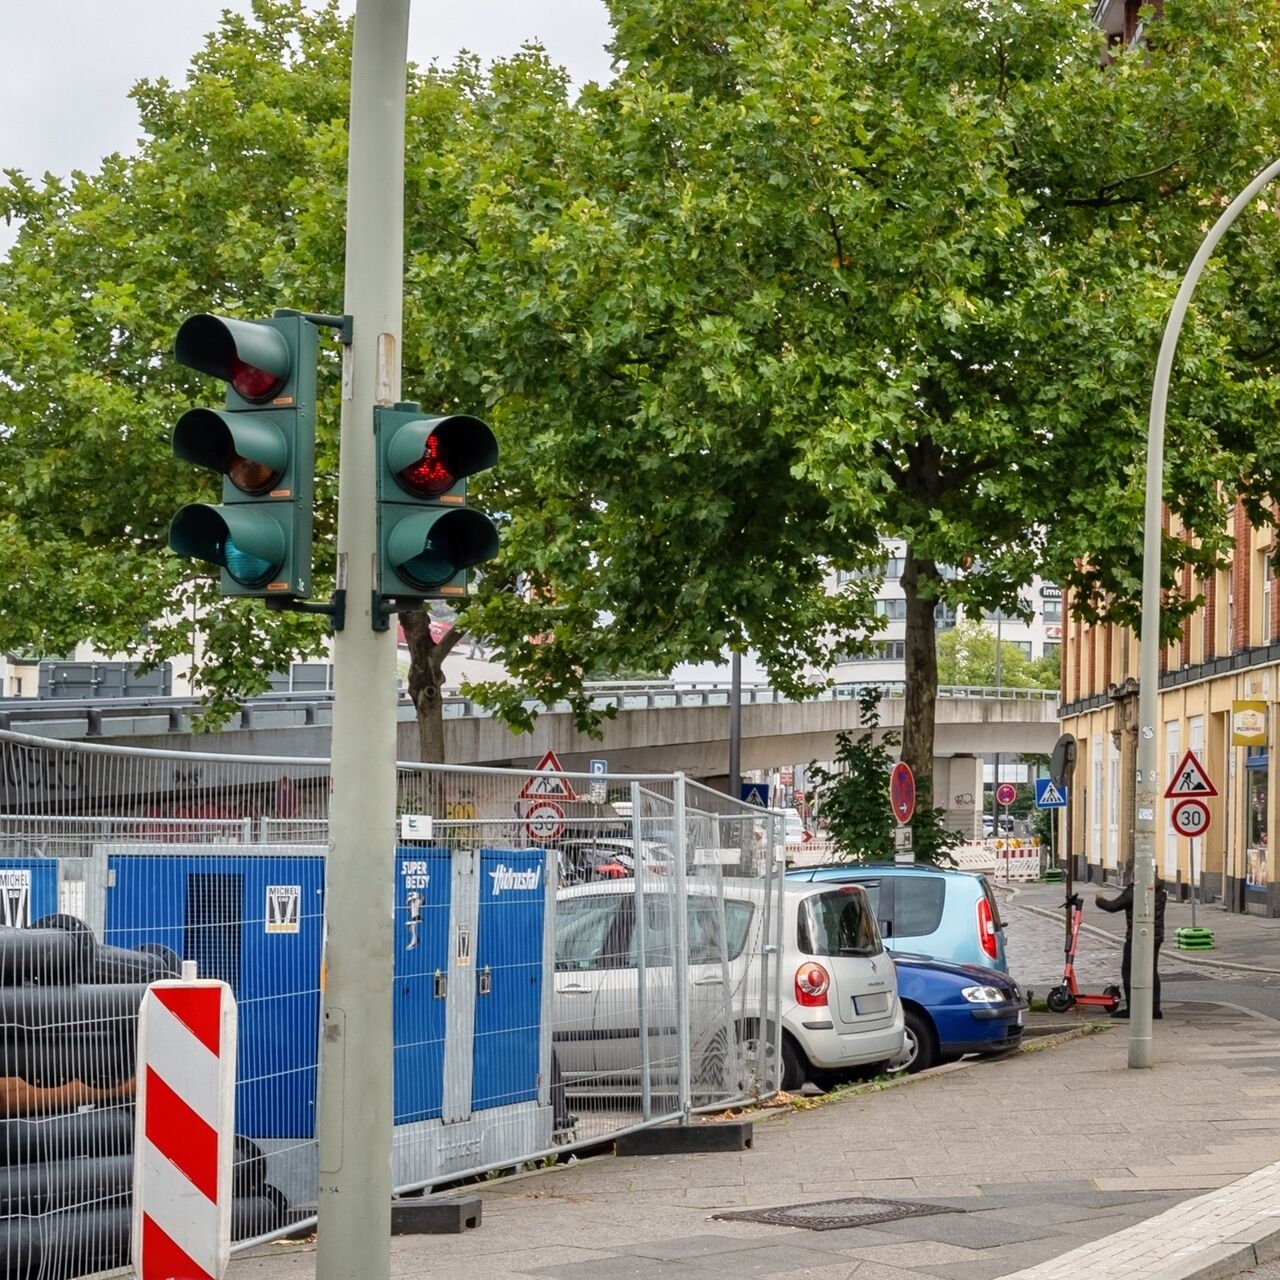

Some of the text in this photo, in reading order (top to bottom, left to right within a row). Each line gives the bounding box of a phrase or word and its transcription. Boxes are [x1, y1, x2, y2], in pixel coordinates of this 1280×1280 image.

[534, 815, 555, 831] 30
[1181, 811, 1201, 827] 30
[401, 861, 427, 875] SUPER
[0, 874, 28, 886] MICHEL
[405, 875, 430, 889] BETSY
[269, 887, 298, 896] MICHEL
